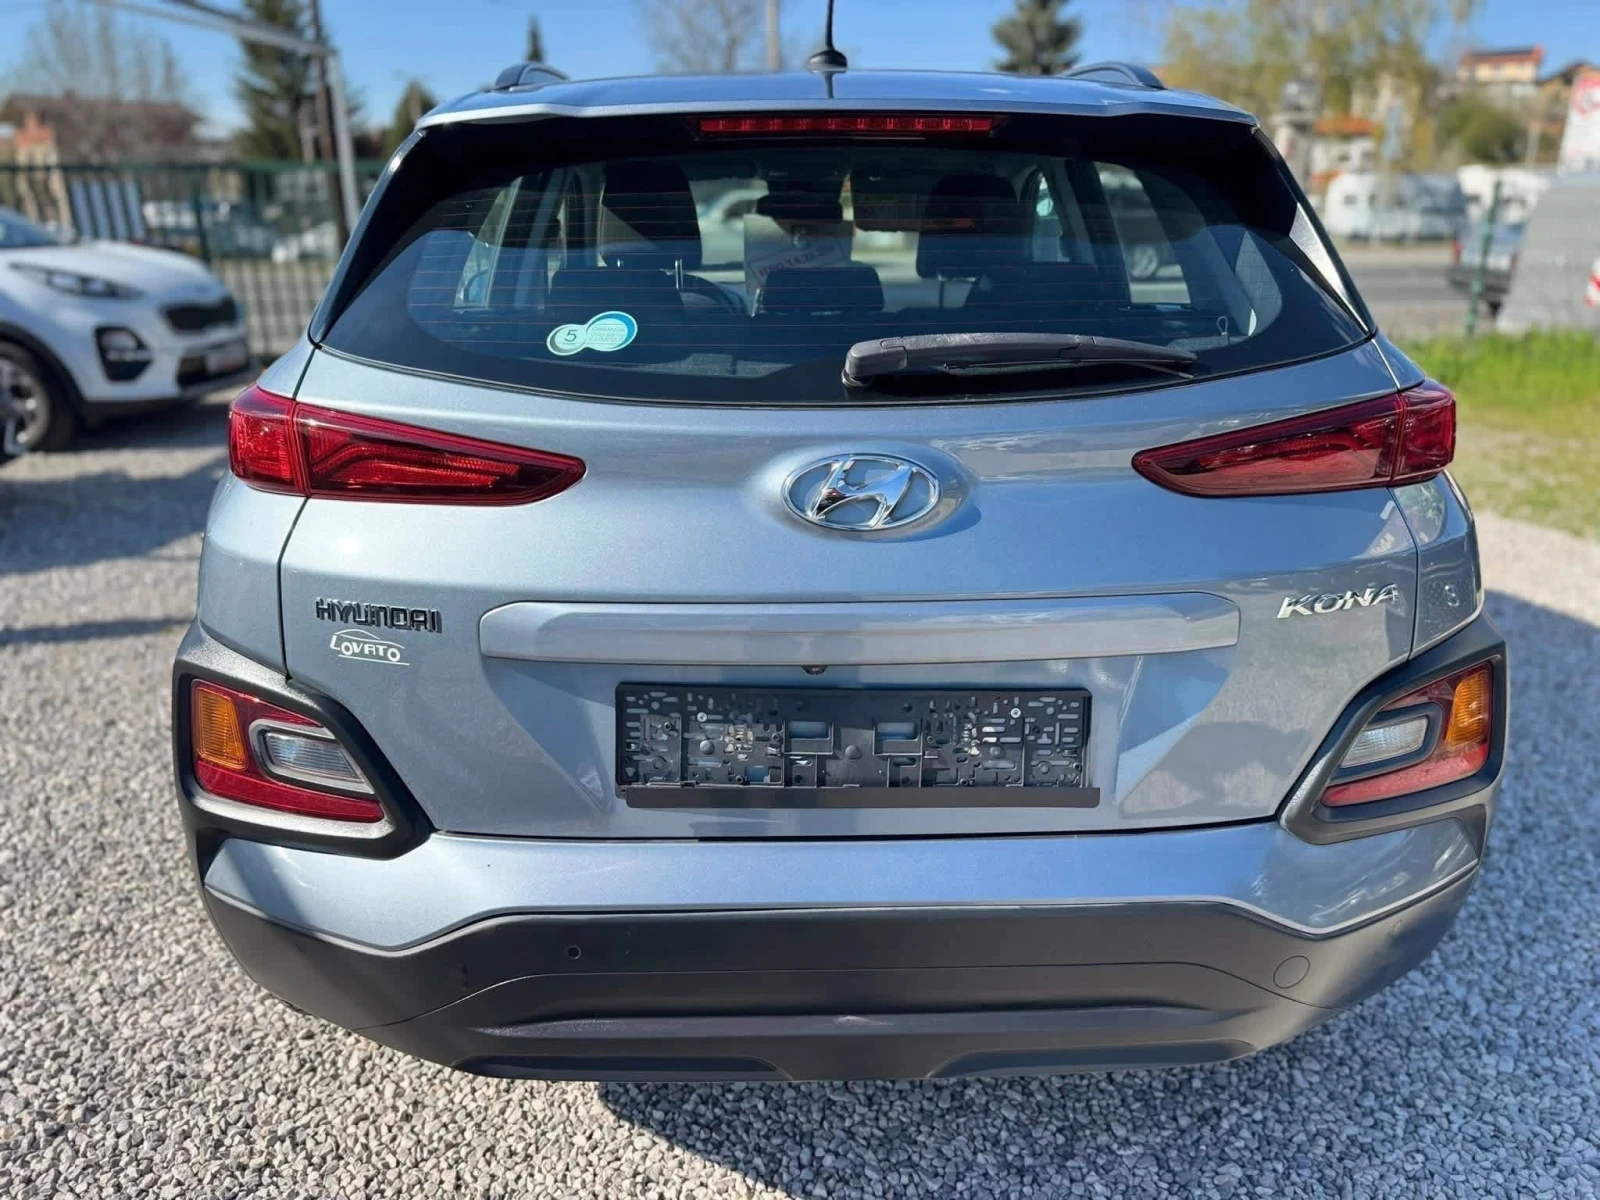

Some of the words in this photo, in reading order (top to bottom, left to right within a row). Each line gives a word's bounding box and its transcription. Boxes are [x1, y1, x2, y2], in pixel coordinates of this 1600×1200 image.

[564, 329, 578, 343] 5
[315, 597, 442, 634] HYUNDAI
[1276, 583, 1399, 619] KONA
[330, 634, 401, 663] LOVATO
